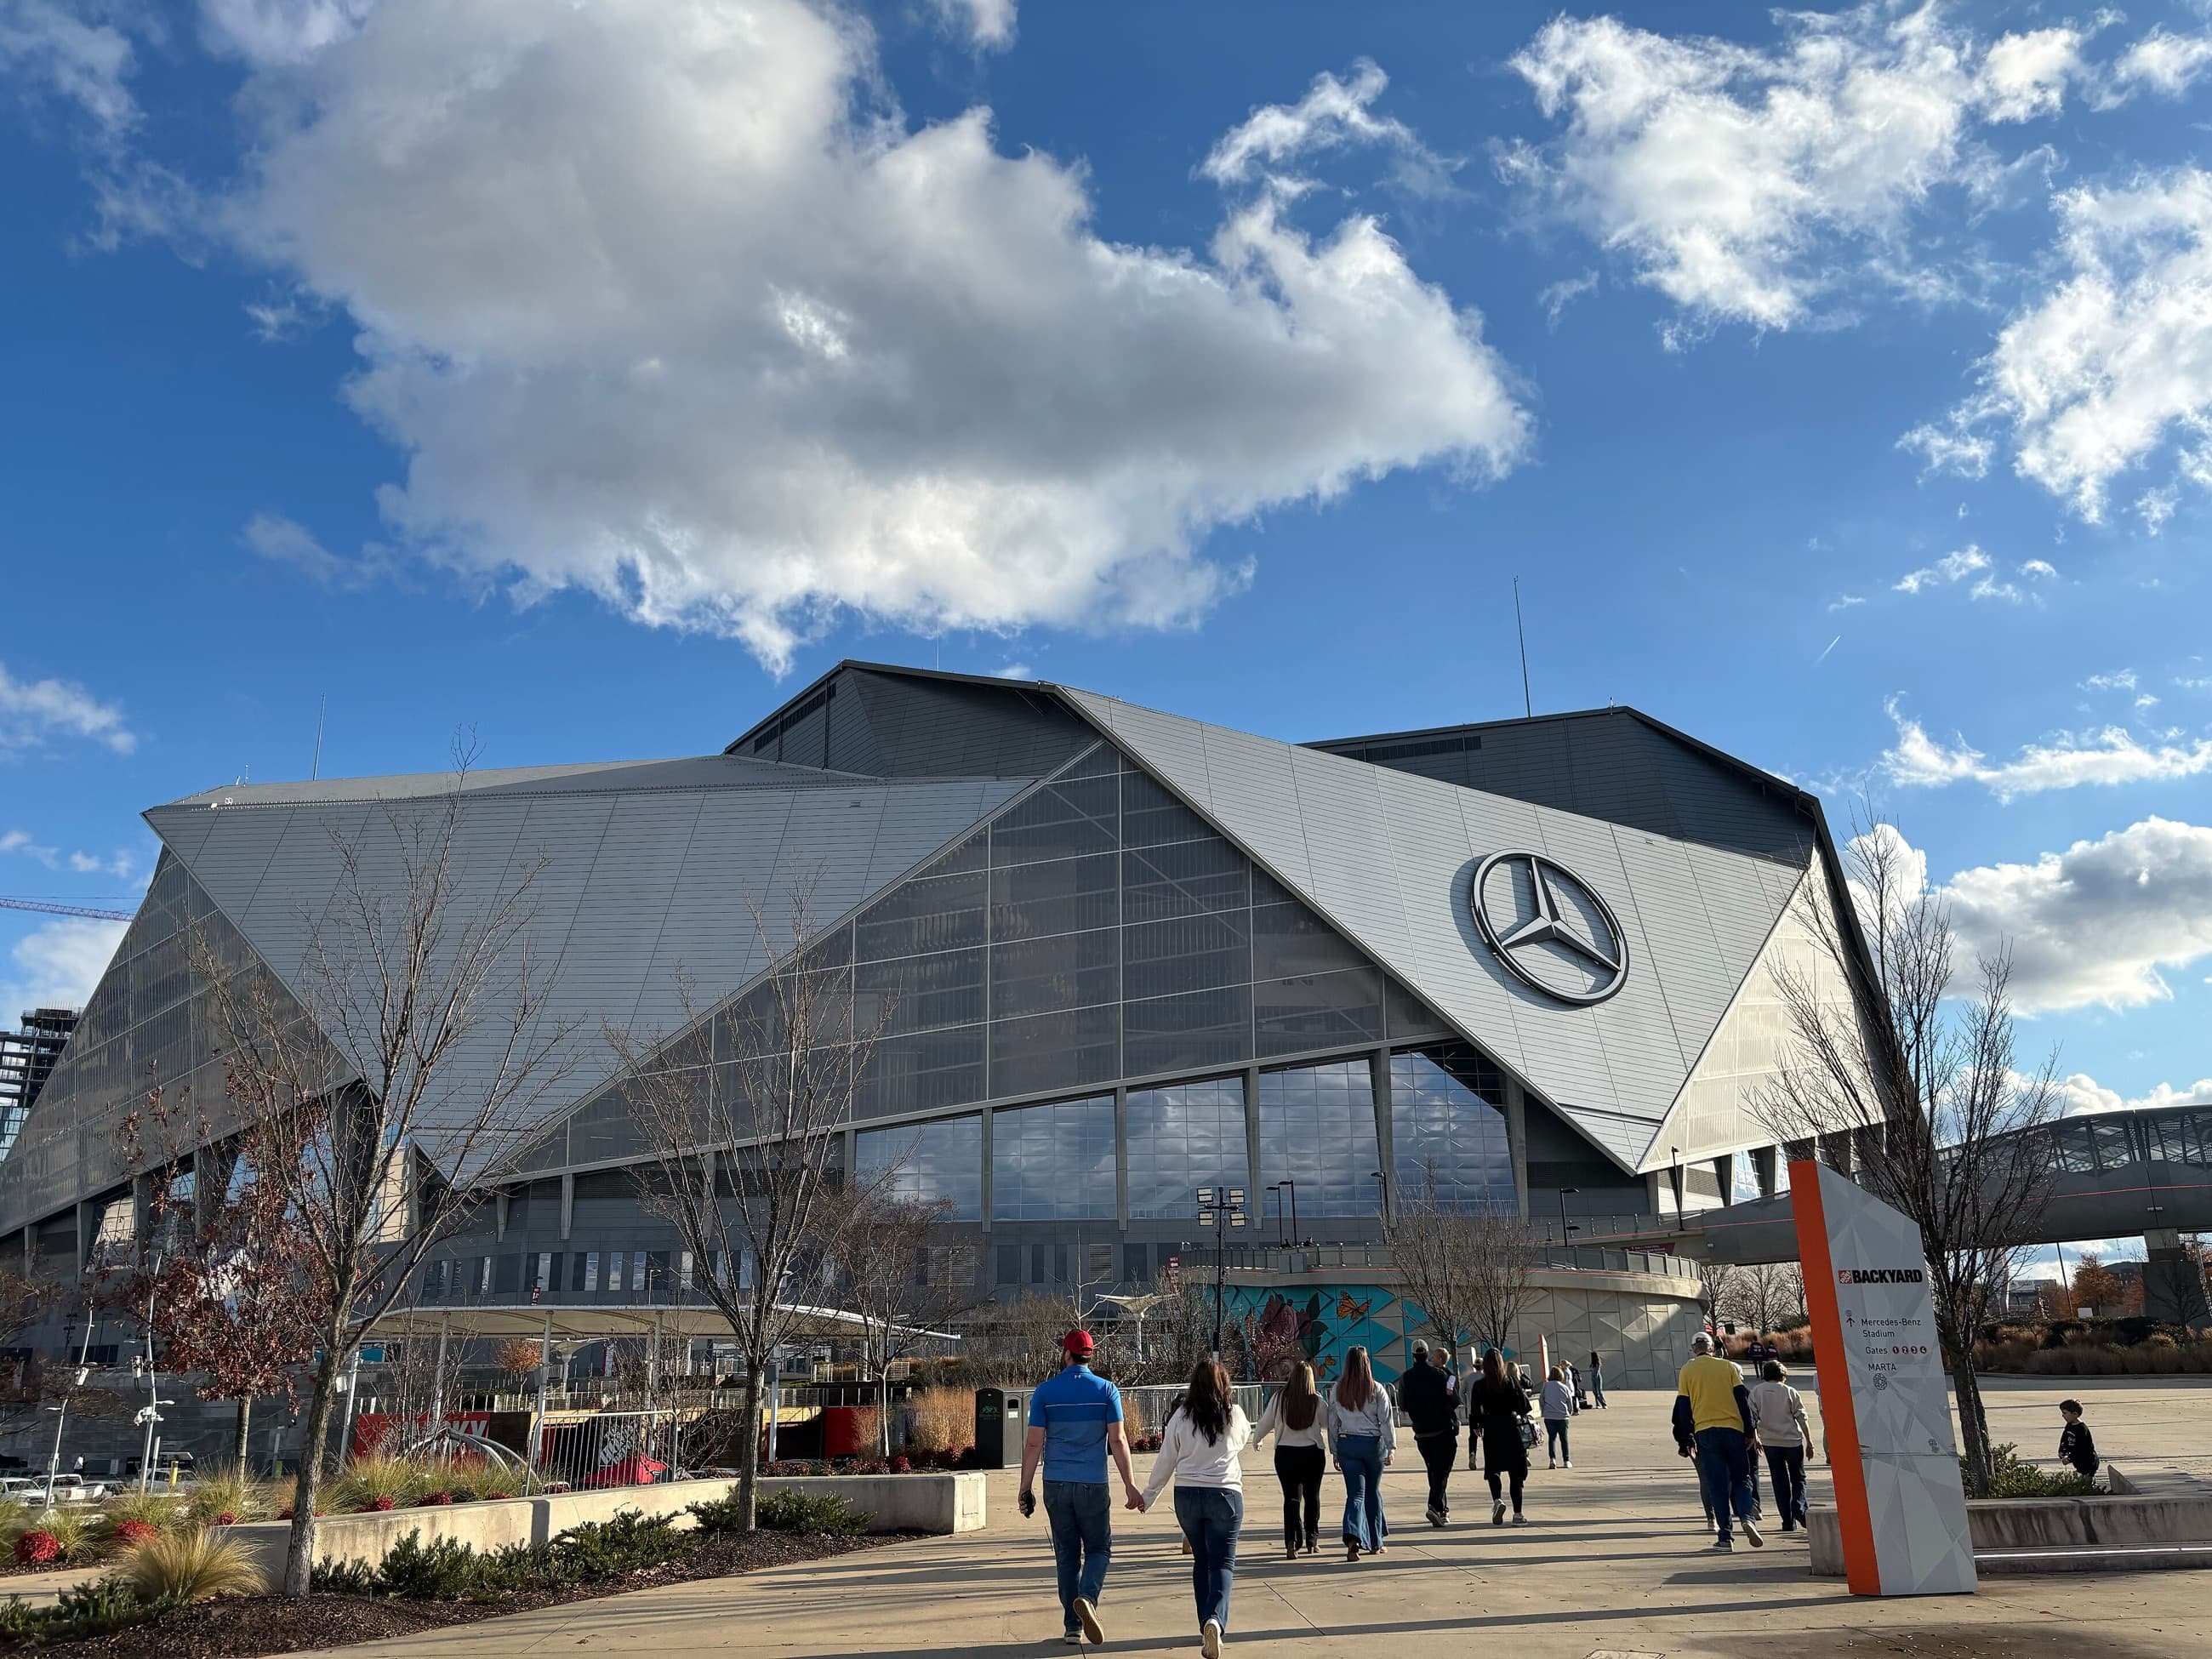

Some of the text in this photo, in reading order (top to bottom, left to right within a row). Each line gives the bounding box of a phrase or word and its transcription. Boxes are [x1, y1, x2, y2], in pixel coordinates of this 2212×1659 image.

[1852, 1269, 1923, 1284] BACKYARD
[1861, 1318, 1922, 1326] Mercedes-Benz
[1865, 1346, 1888, 1354] Gates
